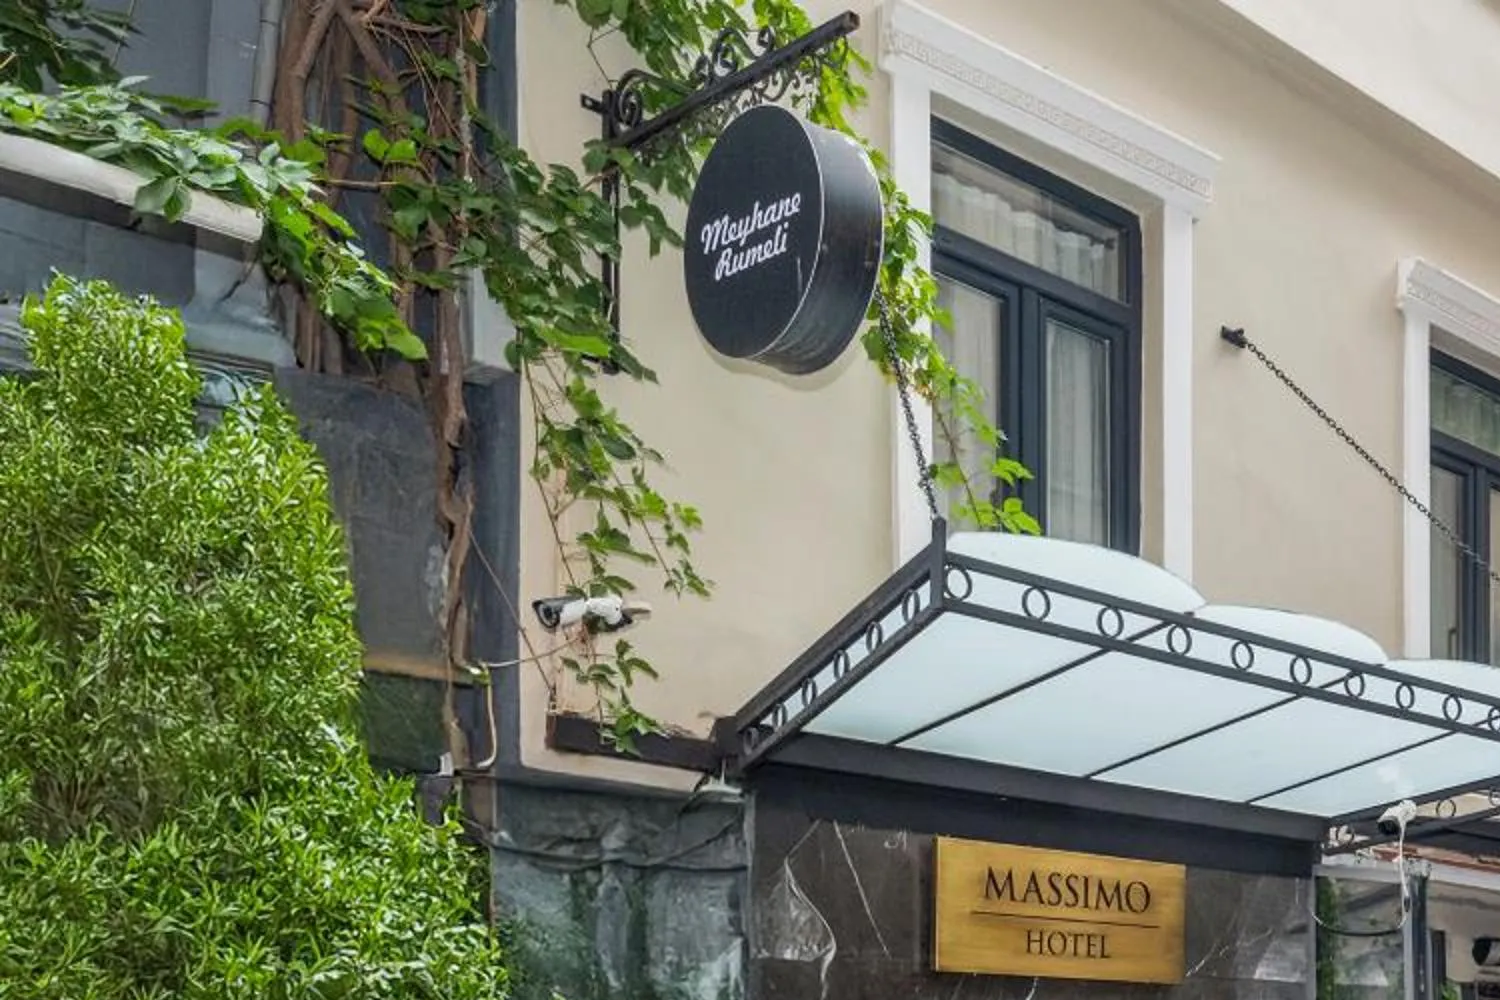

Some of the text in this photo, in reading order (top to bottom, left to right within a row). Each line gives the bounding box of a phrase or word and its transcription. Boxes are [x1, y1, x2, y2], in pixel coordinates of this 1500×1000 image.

[701, 193, 801, 254] Meyhane
[715, 222, 788, 281] Rumeli
[984, 866, 1151, 914] MASSIMO
[1026, 929, 1112, 959] HOTEL
